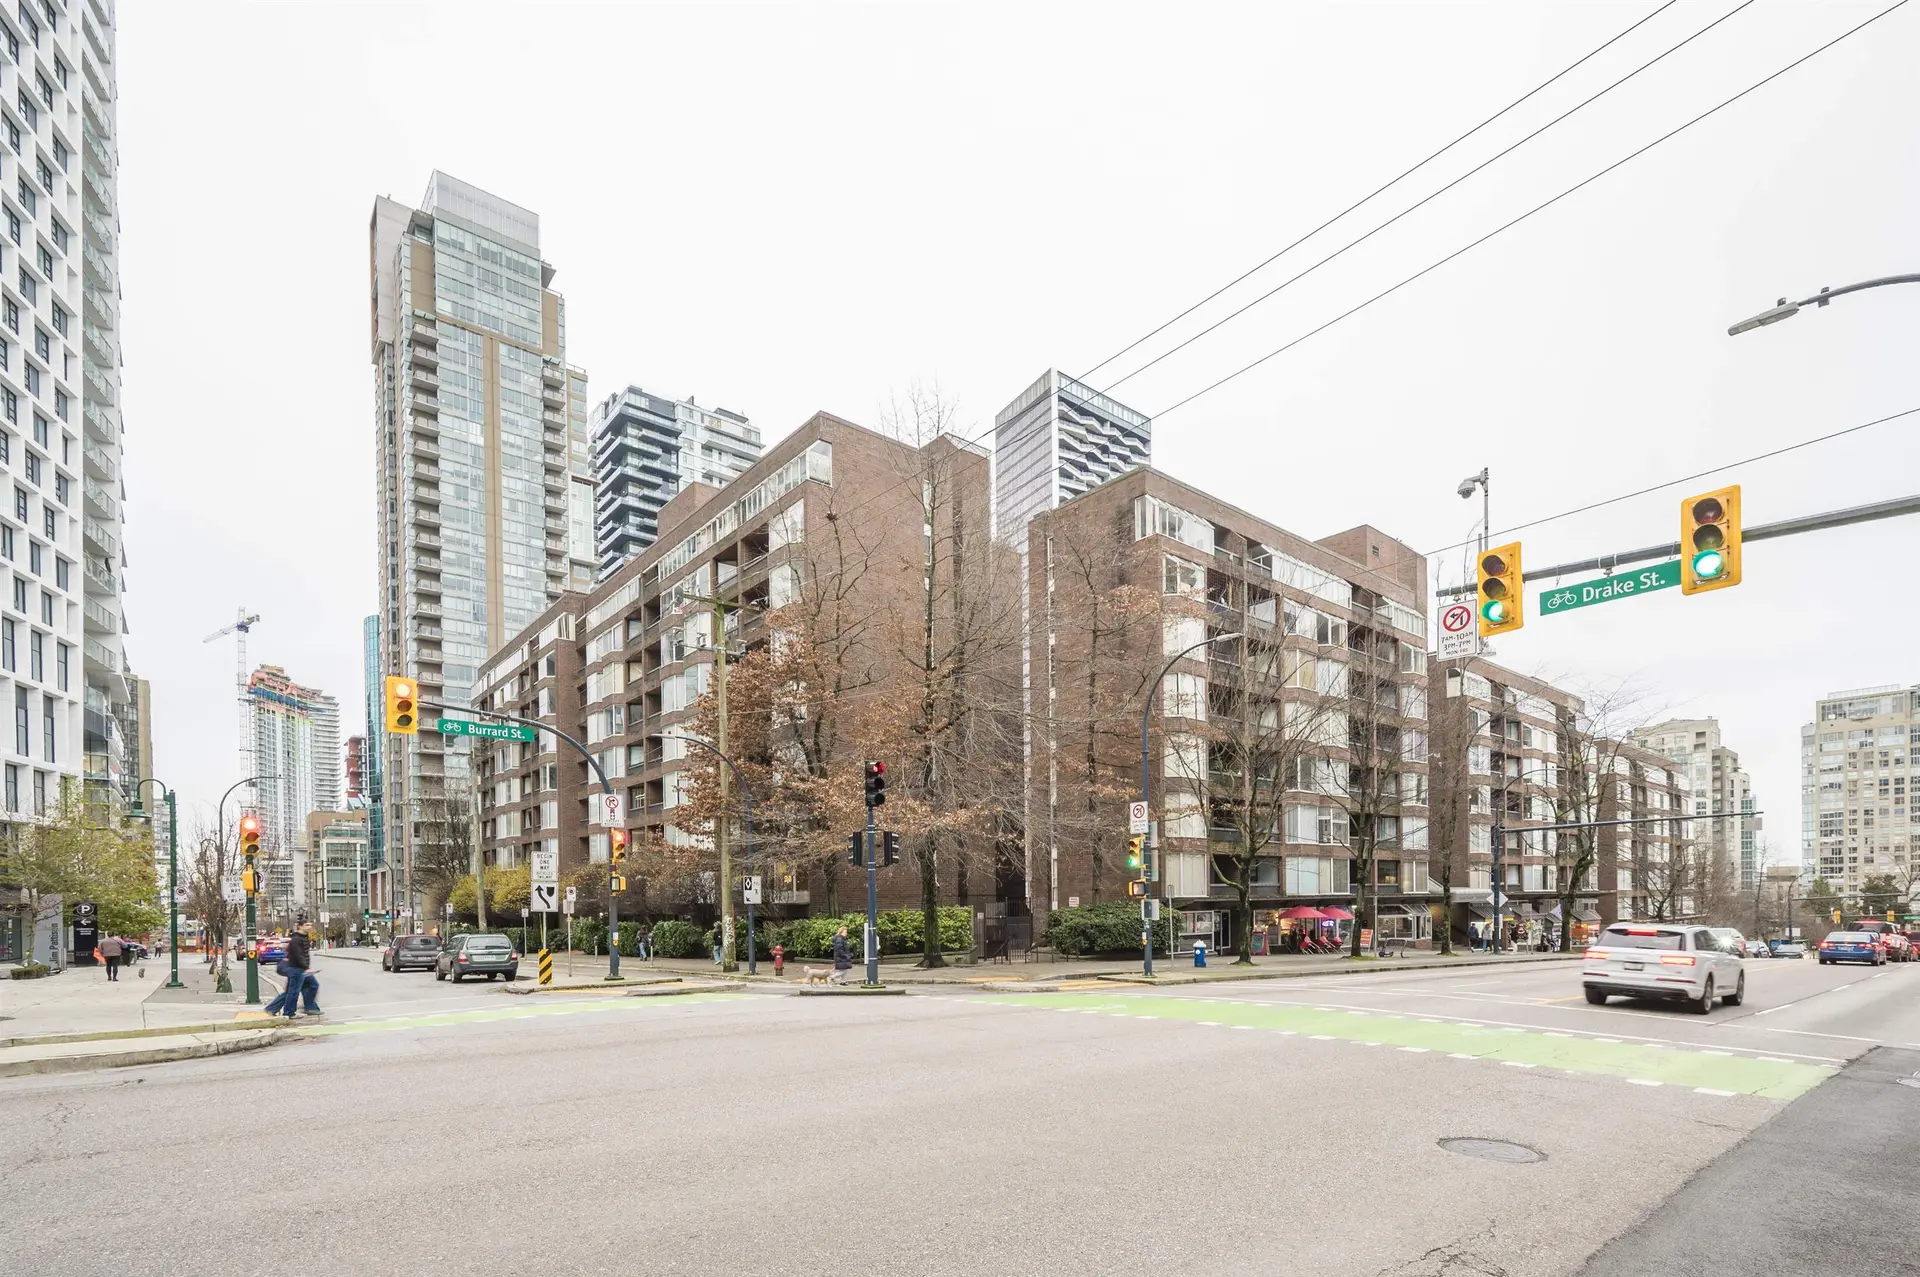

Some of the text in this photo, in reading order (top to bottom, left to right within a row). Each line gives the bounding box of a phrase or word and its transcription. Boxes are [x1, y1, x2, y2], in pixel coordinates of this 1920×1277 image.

[1582, 571, 1666, 602] Drake St.
[468, 724, 526, 739] Burrard St.
[48, 923, 59, 963] Jim Pattison
